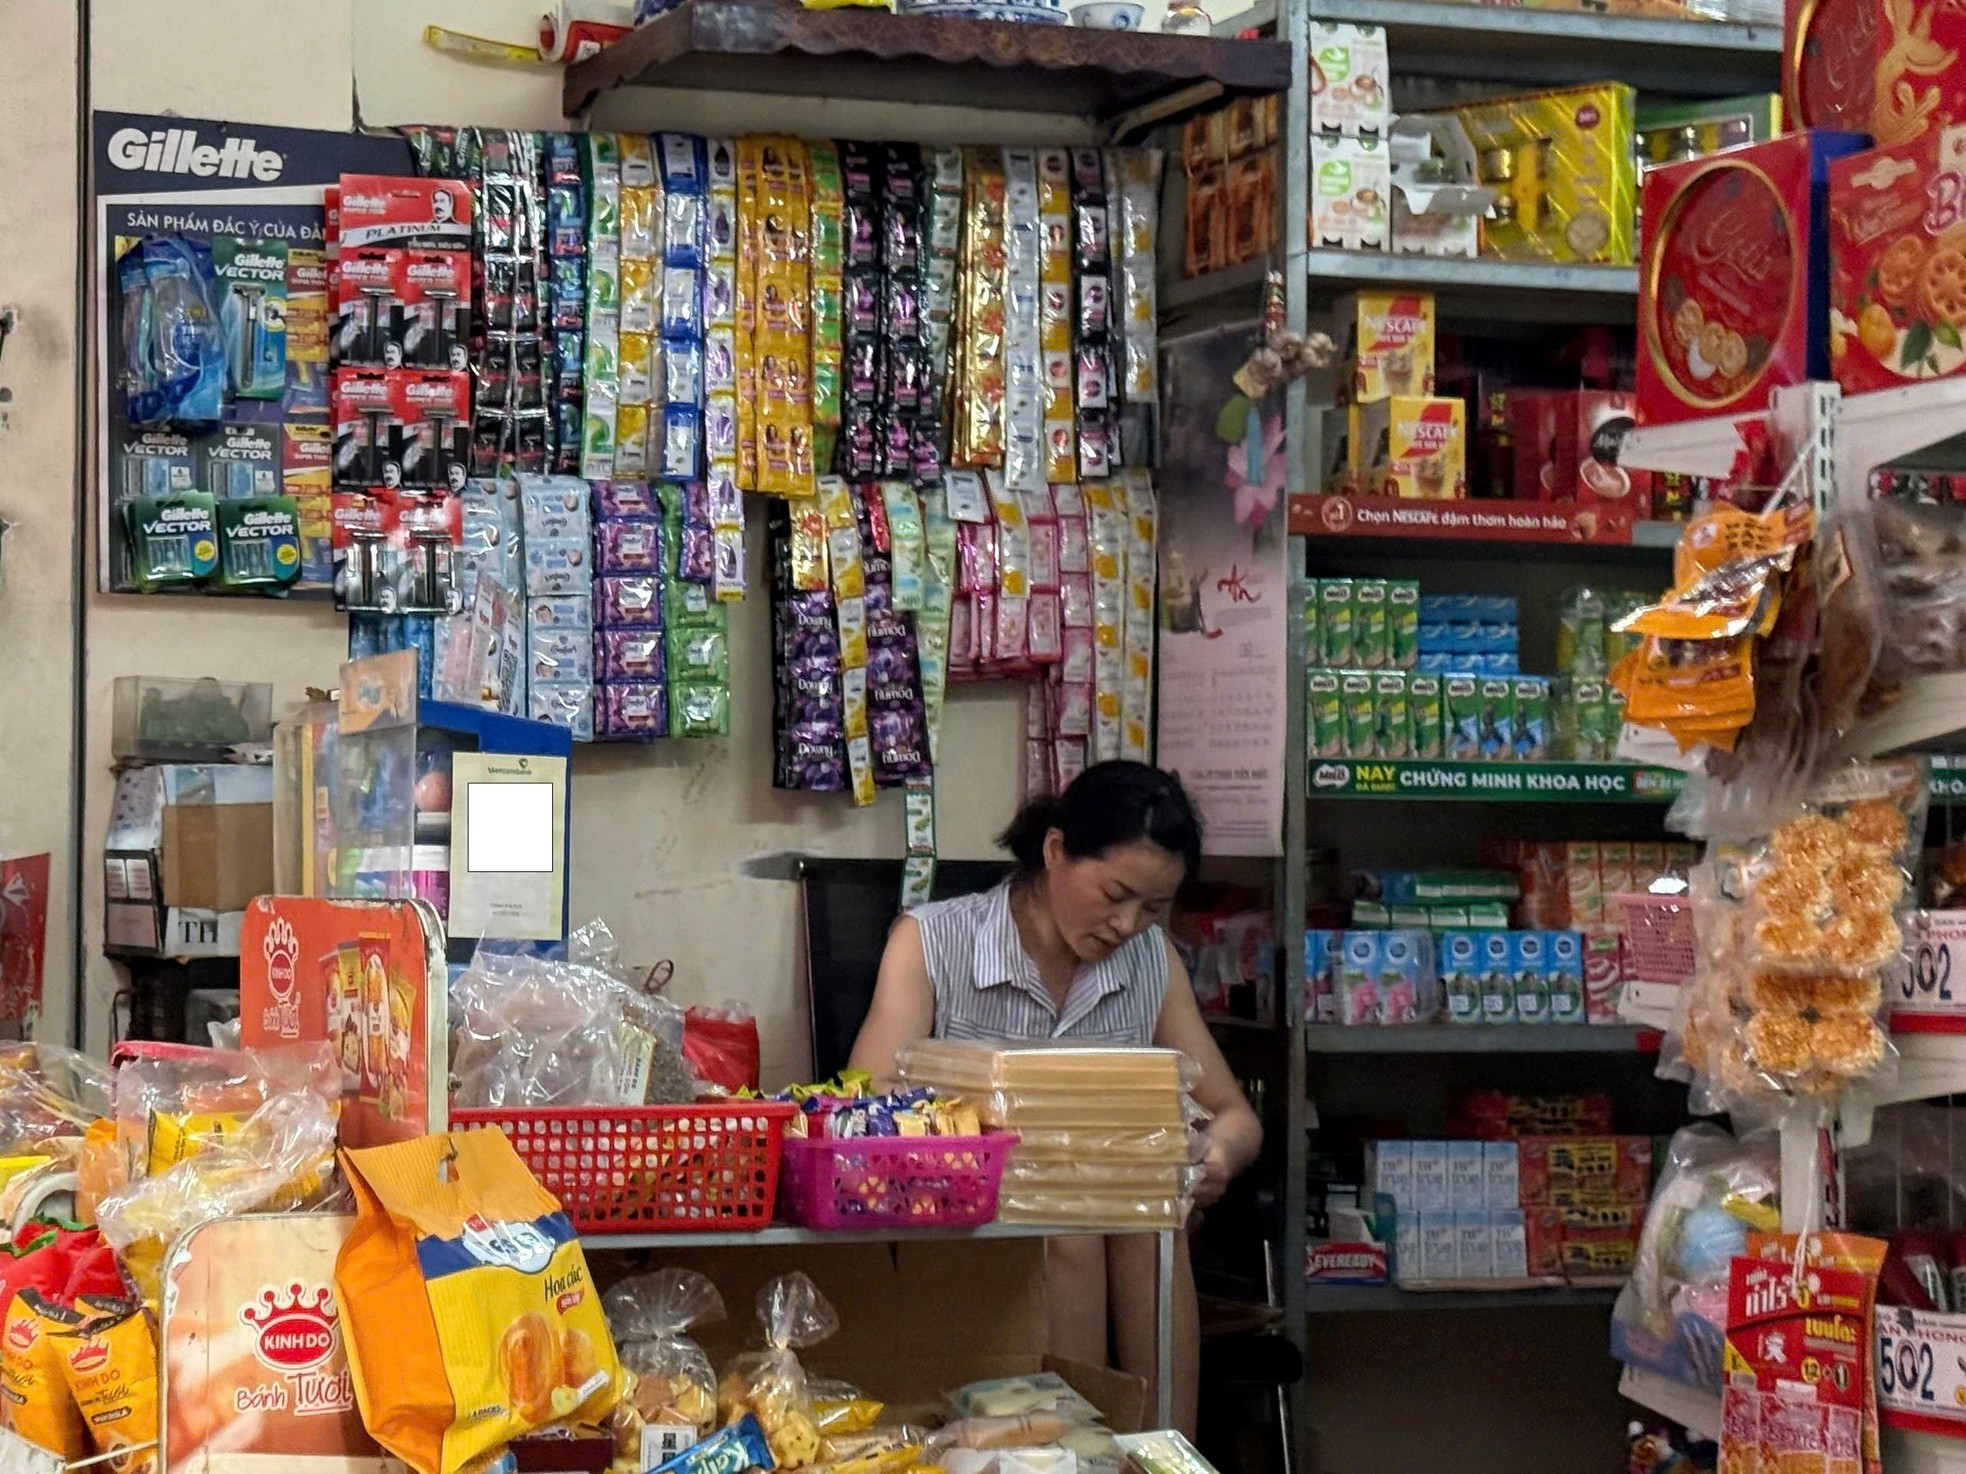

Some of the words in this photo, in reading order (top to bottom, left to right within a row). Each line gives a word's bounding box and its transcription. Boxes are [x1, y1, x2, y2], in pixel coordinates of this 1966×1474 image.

[108, 127, 283, 182] Gillette
[365, 223, 442, 240] PLATINUM
[234, 253, 285, 270] Gillette
[214, 264, 285, 281] VECTOR
[142, 433, 188, 447] Gillette
[226, 437, 272, 450] Gillette
[123, 442, 188, 457] VECTOR
[208, 447, 272, 461] VECTOR
[161, 507, 210, 522] Gillette
[243, 511, 292, 526] Gillette
[1357, 508, 1390, 525] Chọn
[143, 520, 212, 535] VECTOR
[226, 524, 294, 538] VECTOR
[1355, 764, 1396, 782] NAY
[1400, 767, 1467, 788] CHỨNG
[1471, 772, 1522, 789] MINH
[1526, 774, 1581, 790] KHOA
[1585, 775, 1626, 794] HỌC
[1880, 1336, 1935, 1401] 502
[236, 1383, 286, 1411] Bánh
[286, 1367, 353, 1406] Tươi
